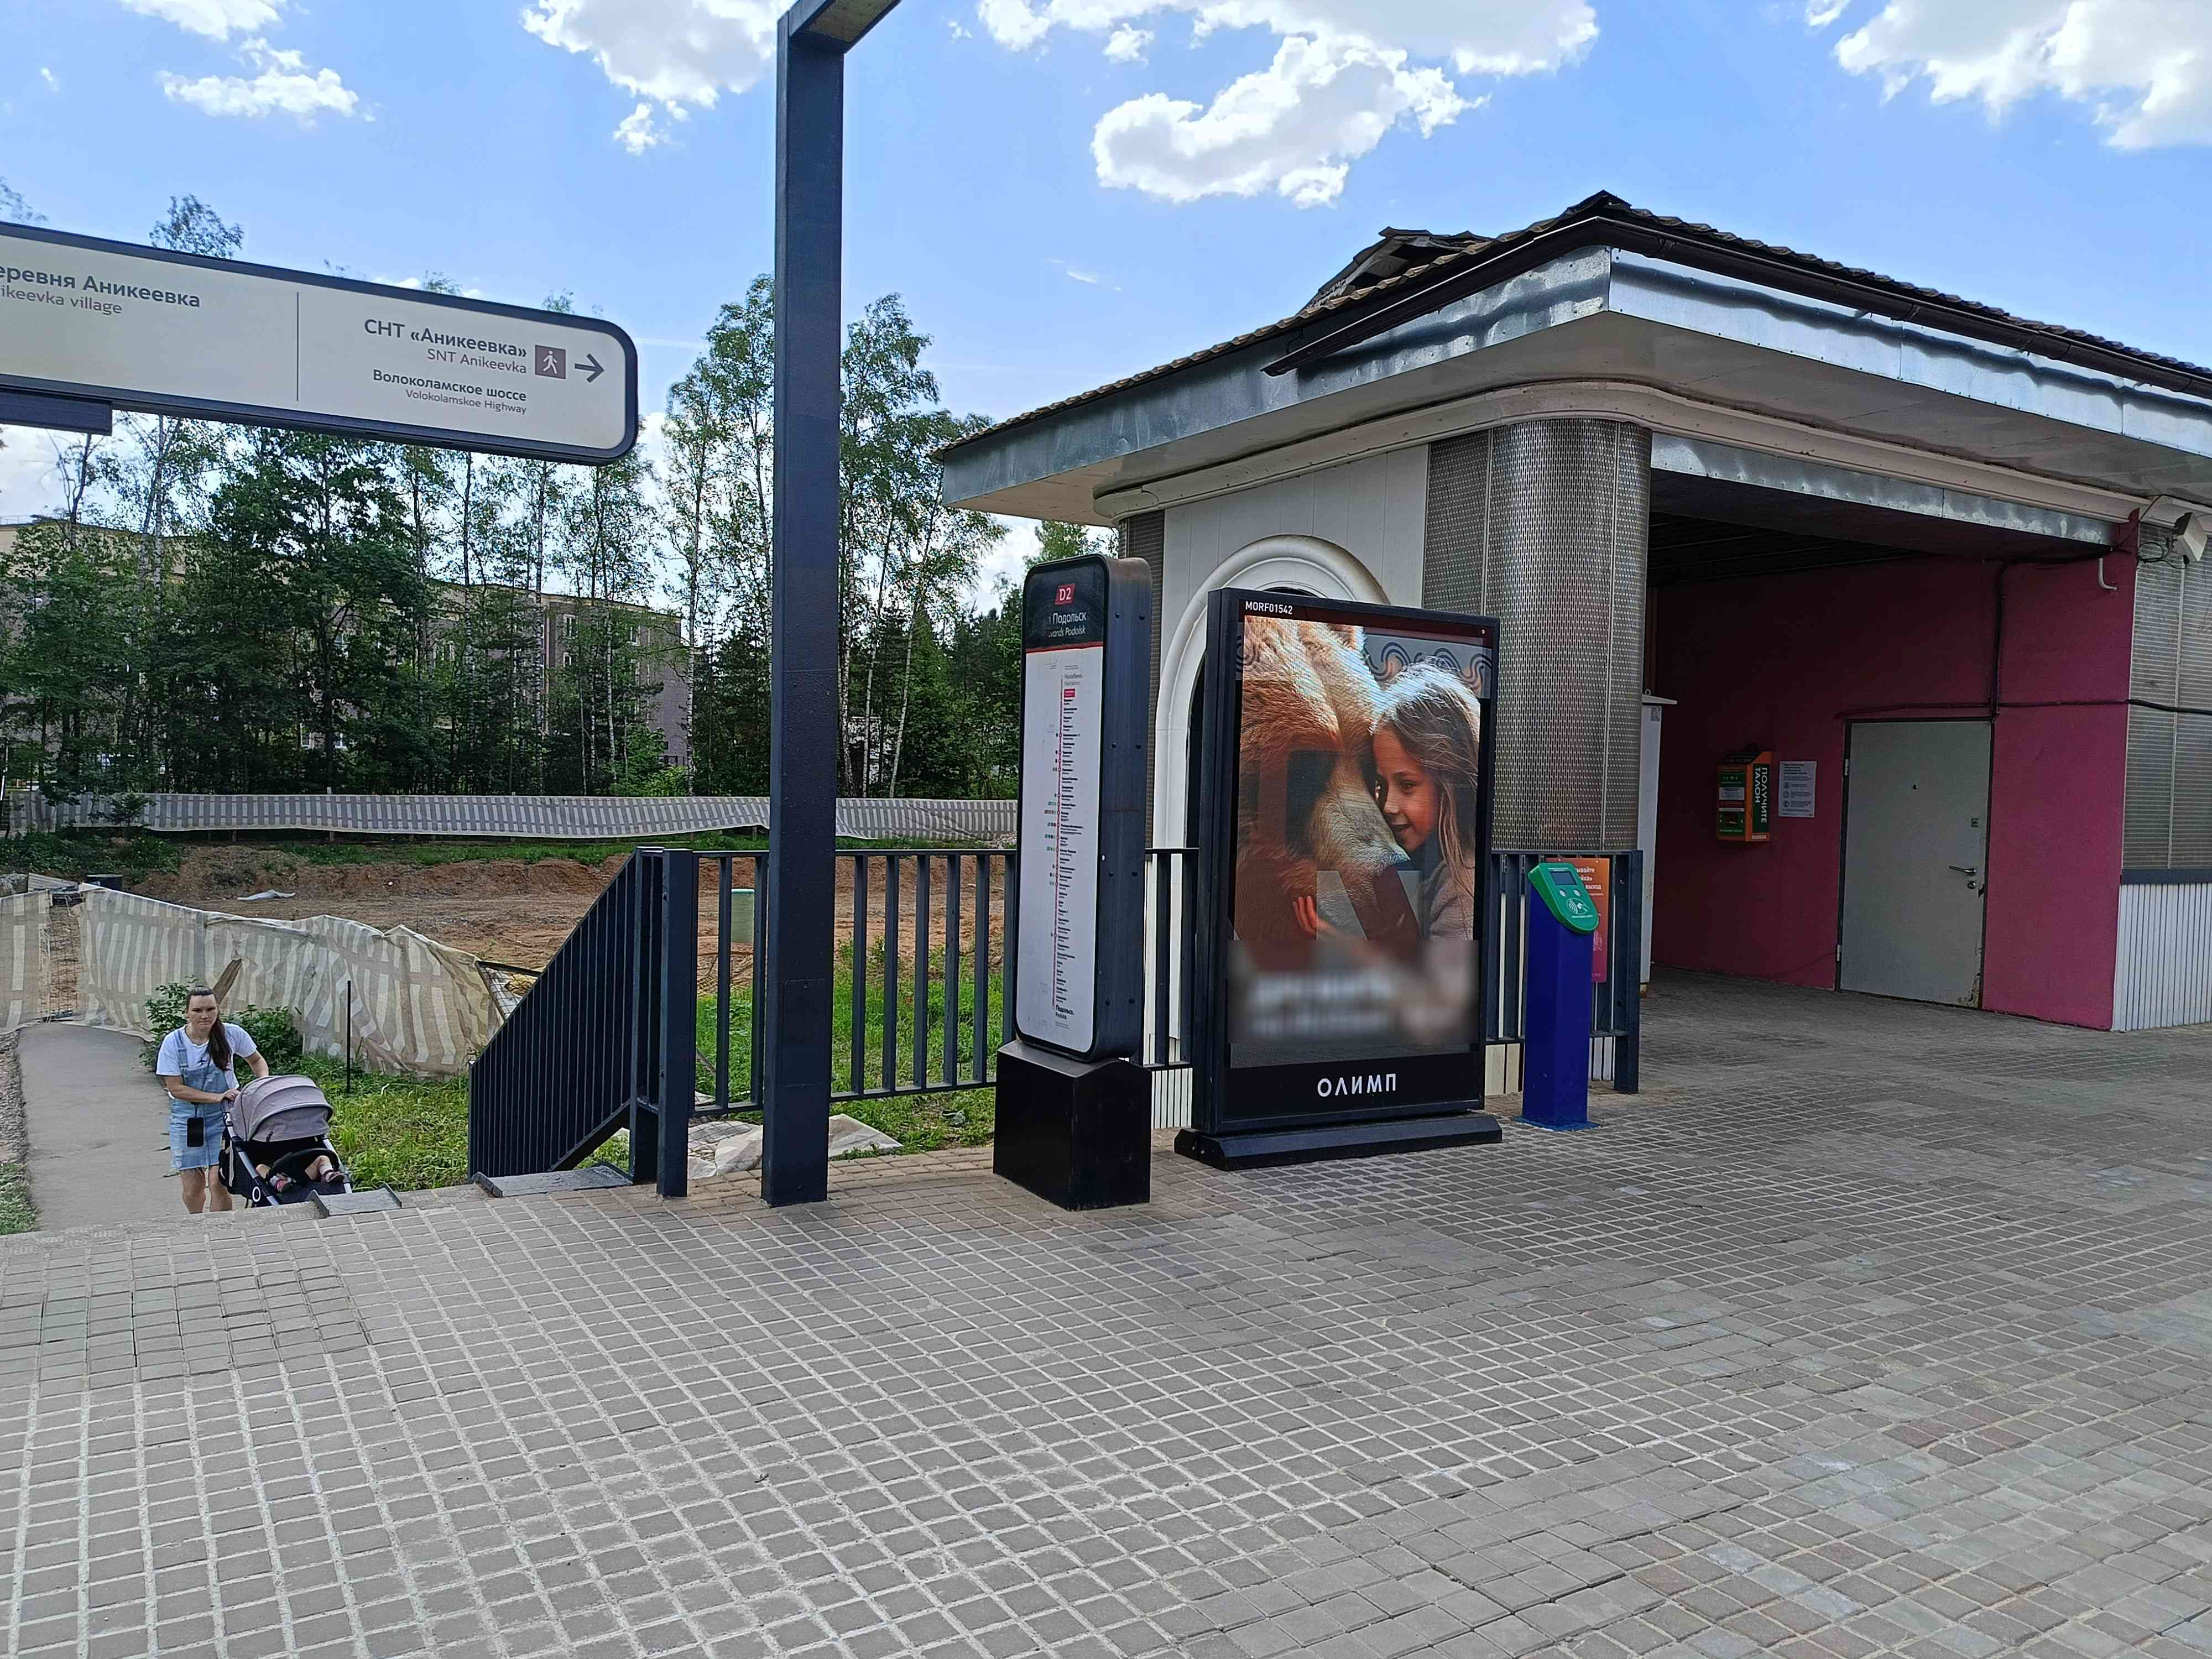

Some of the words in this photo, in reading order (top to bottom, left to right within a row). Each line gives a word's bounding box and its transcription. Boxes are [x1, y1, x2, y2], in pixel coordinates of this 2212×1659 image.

[1, 285, 65, 305] ikeevka
[70, 296, 122, 315] village
[82, 275, 200, 308] Аникеевка
[364, 319, 405, 338] СНТ
[410, 328, 527, 358] «Аникеевка»
[427, 349, 457, 363] SNT
[460, 354, 527, 374] Anikeevka
[373, 369, 483, 395] Волоколамское
[487, 388, 527, 401] шоссе
[406, 389, 482, 408] Volokolamskoe
[484, 399, 527, 415] Highway
[1059, 587, 1071, 601] D2
[1052, 612, 1087, 625] Подольск
[1245, 601, 1293, 614] MORF01542
[1065, 625, 1086, 637] Podolsk
[1317, 1073, 1397, 1097] ОЛИМП
